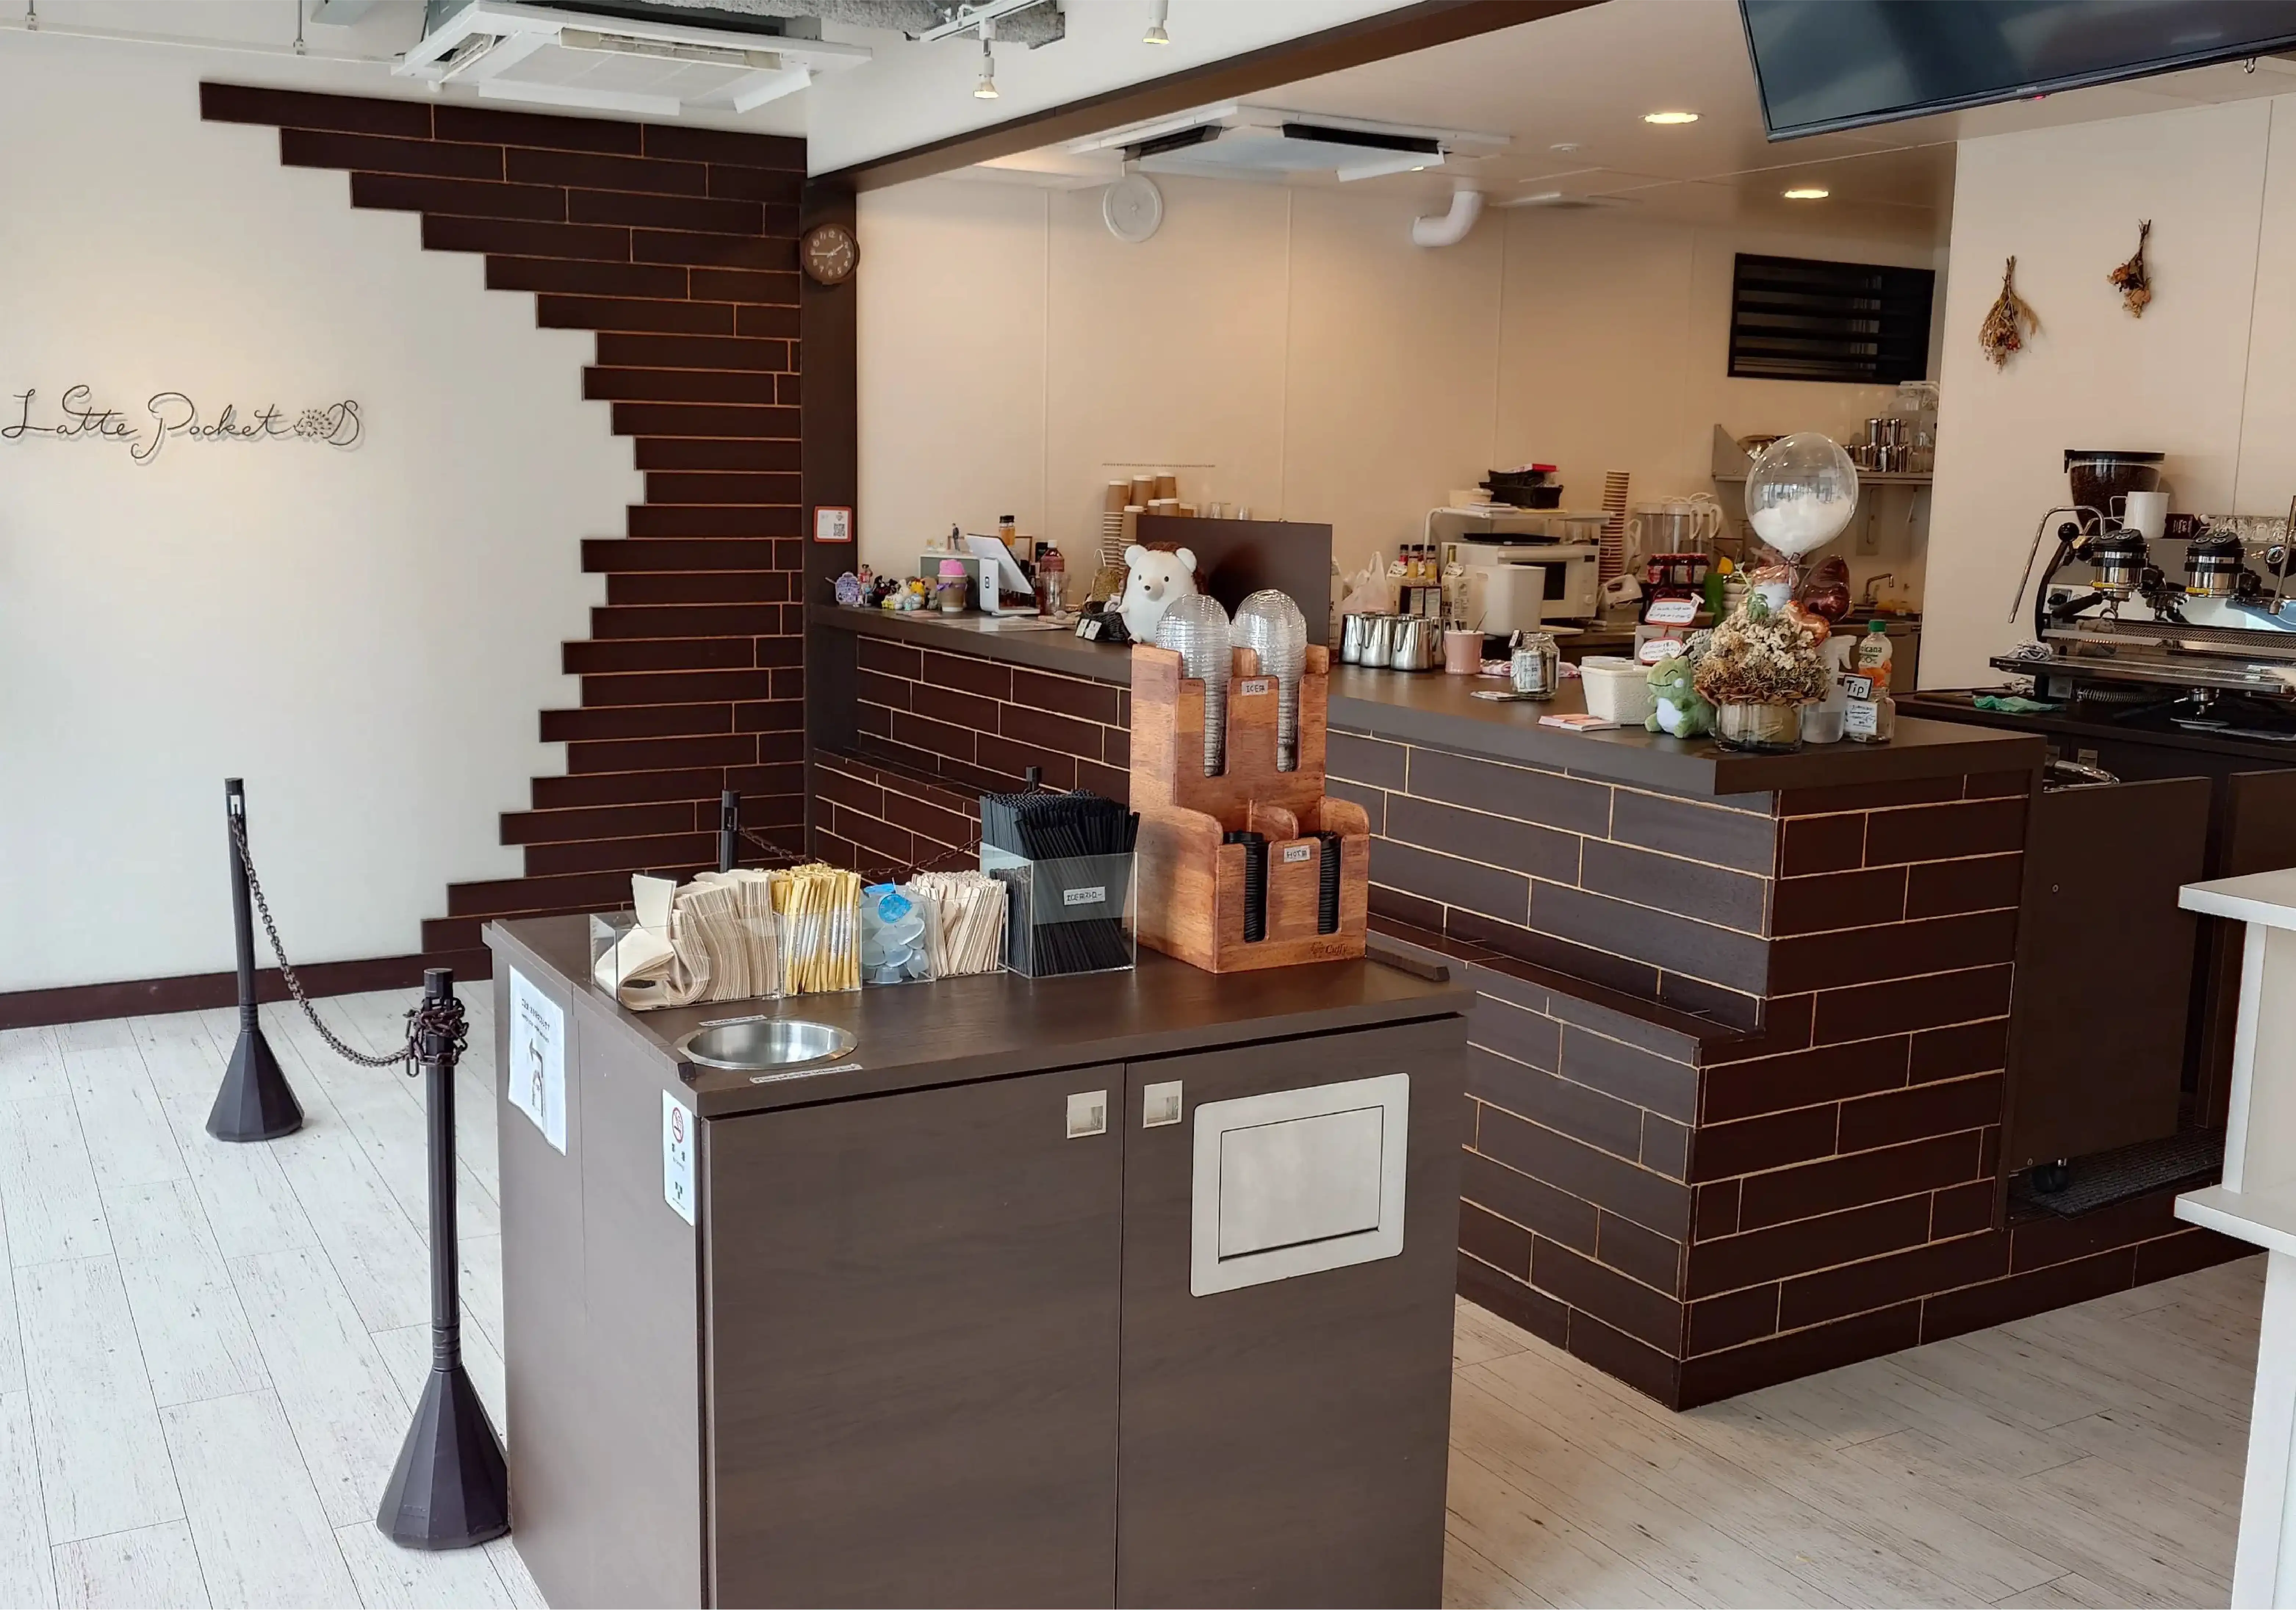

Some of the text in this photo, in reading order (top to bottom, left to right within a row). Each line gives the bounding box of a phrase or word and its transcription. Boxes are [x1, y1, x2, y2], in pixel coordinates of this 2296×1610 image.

[1, 384, 294, 460] Latte Pocket
[1847, 680, 1864, 696] Tip
